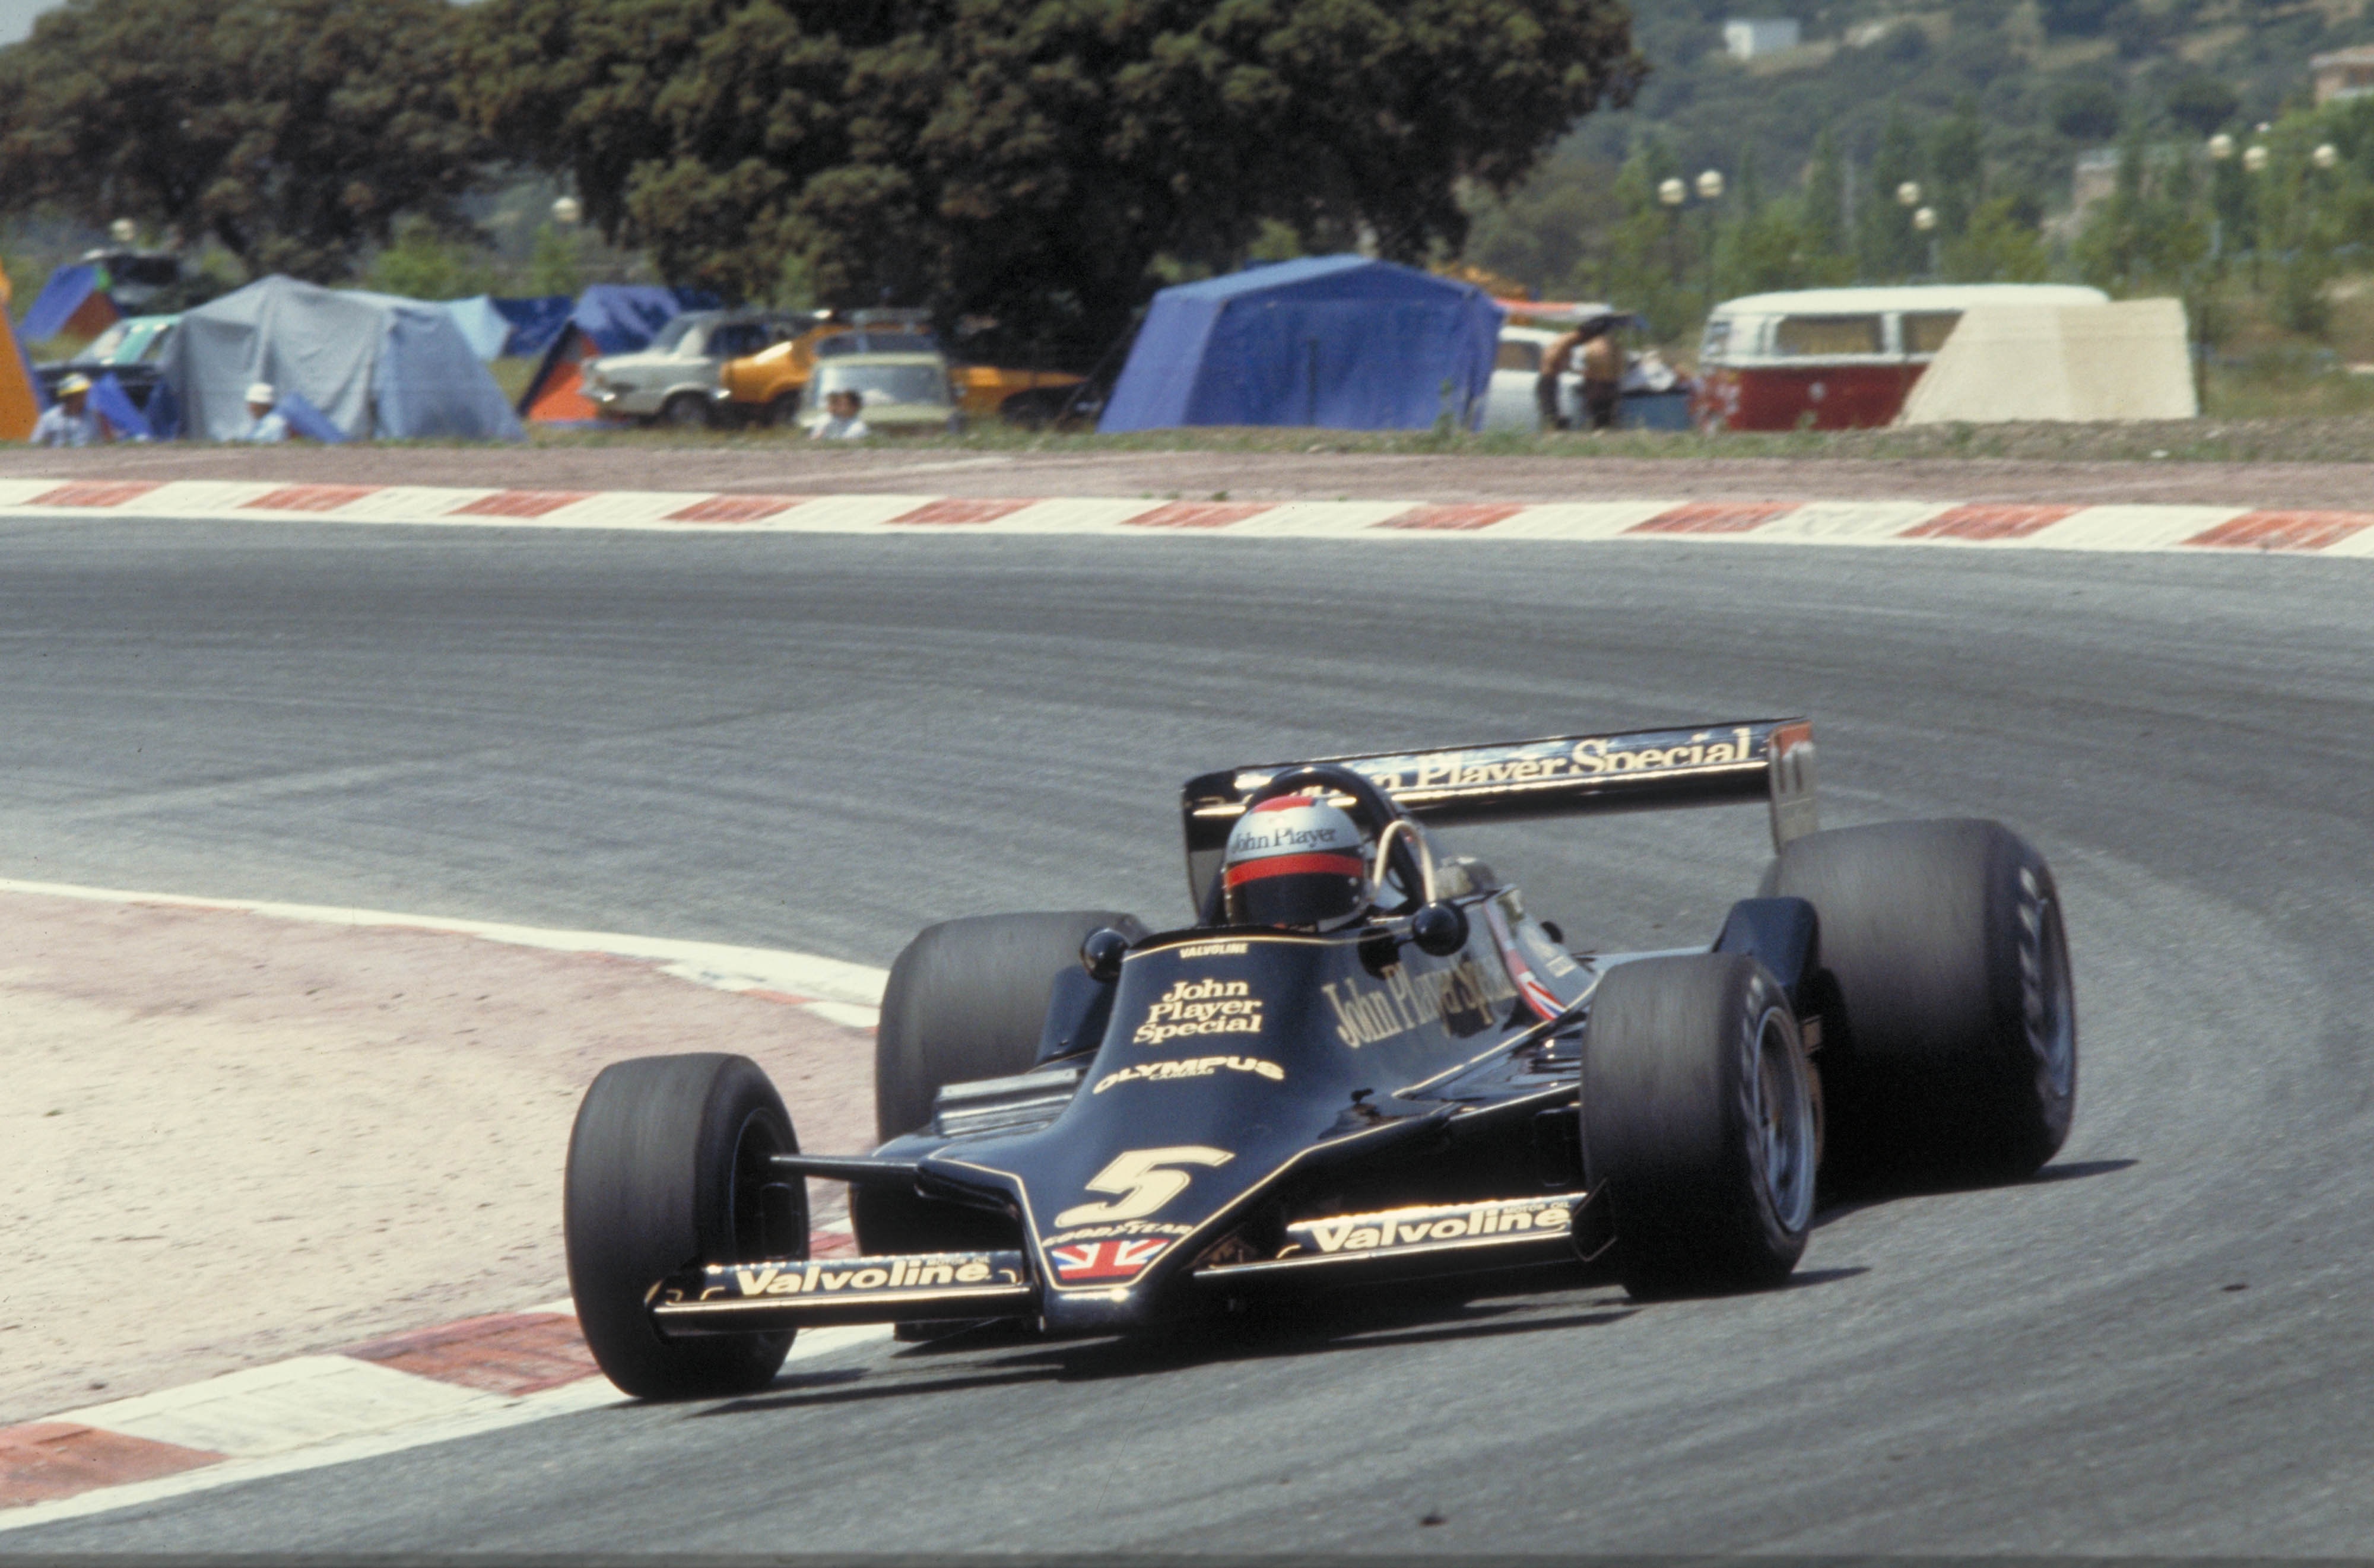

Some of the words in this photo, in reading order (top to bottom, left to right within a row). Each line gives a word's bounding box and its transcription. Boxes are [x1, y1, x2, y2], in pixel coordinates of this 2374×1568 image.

[1569, 727, 1751, 774] Special
[1274, 827, 1337, 849] Player
[1180, 943, 1249, 958] VALVOLINE
[1161, 978, 1249, 1002] John
[1132, 1014, 1262, 1045] Special
[1145, 999, 1263, 1024] Player
[1321, 976, 1403, 1049] John
[1092, 1056, 1285, 1094] OLYMPUS
[1053, 1145, 1236, 1229] 5
[1312, 1207, 1572, 1252] Valvoline
[735, 1258, 991, 1296] Valvoline
